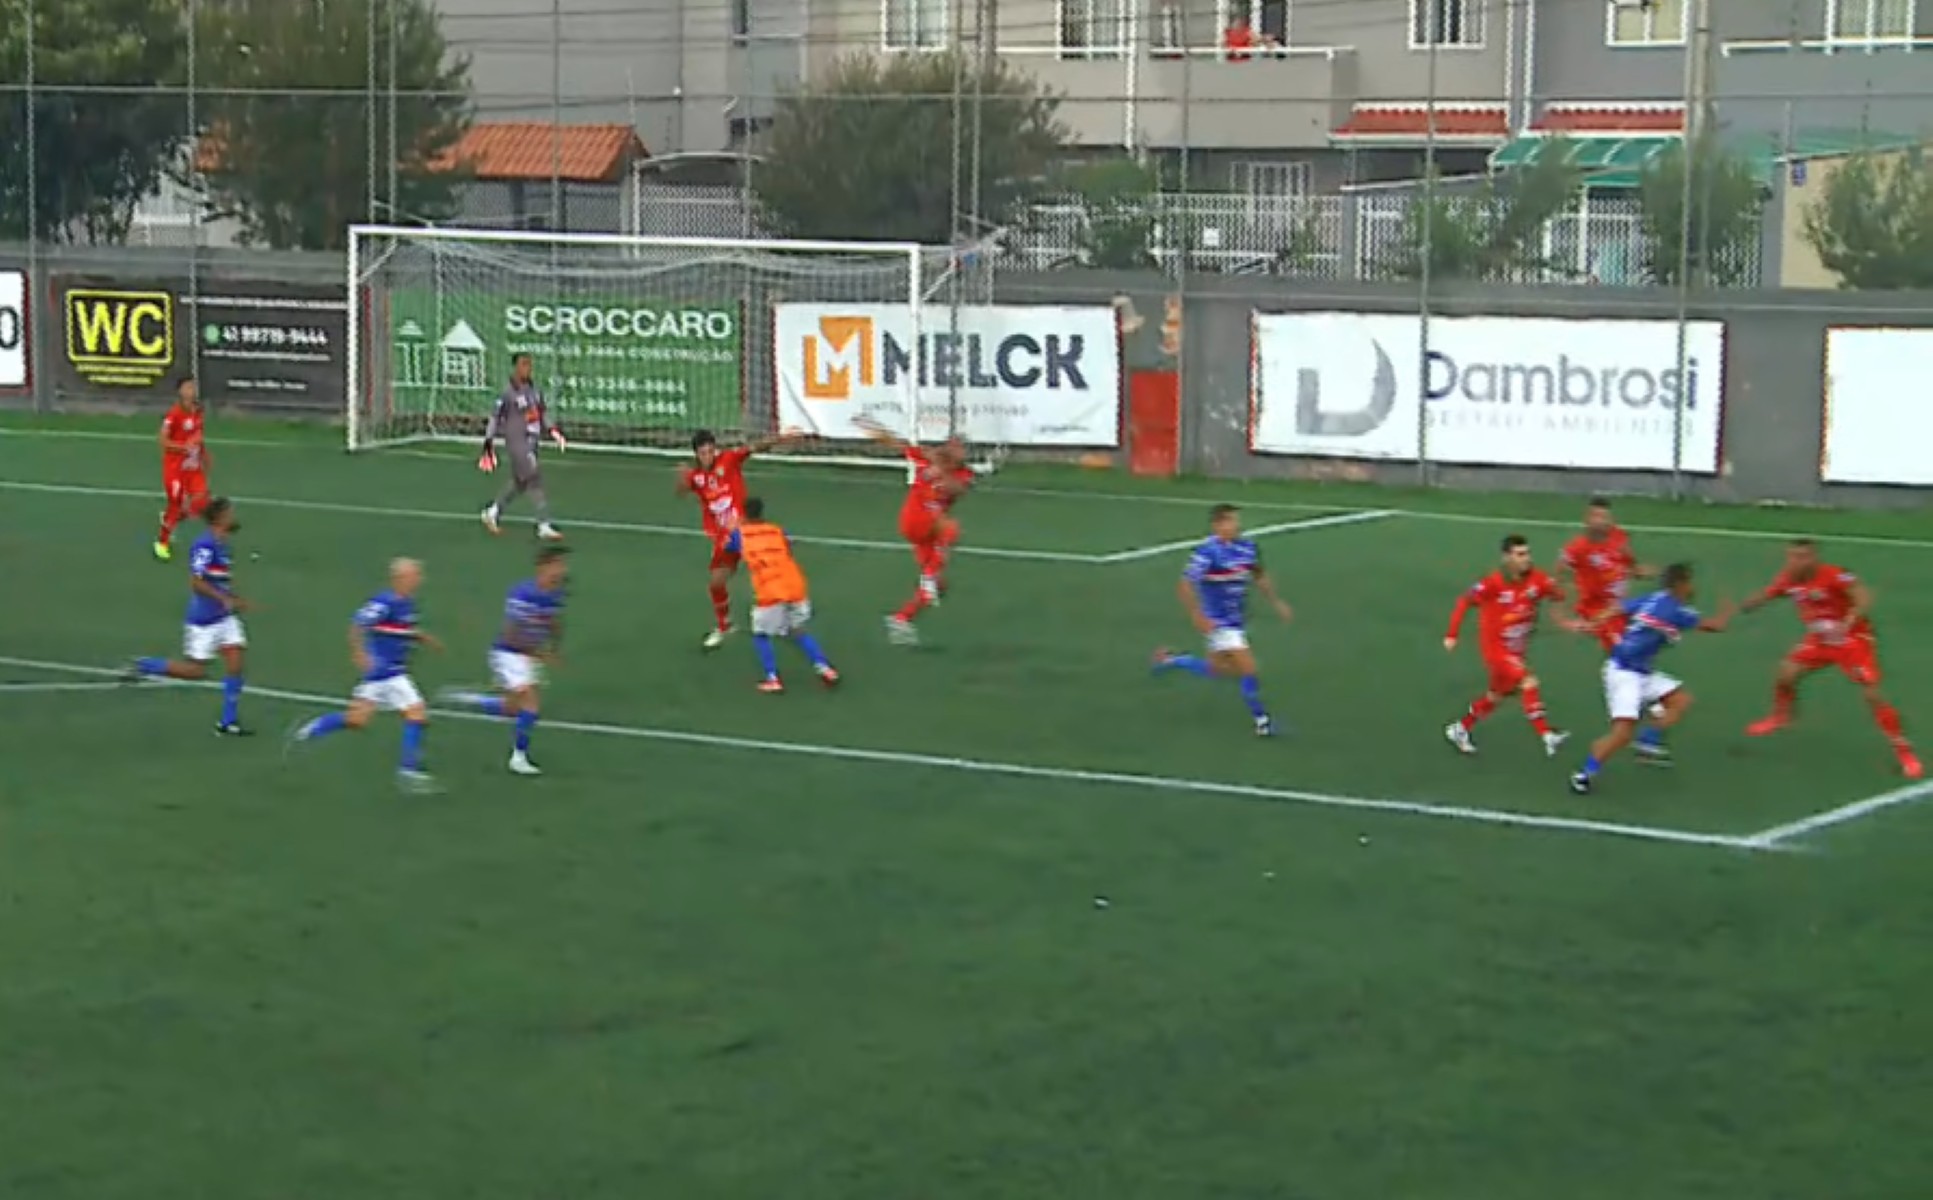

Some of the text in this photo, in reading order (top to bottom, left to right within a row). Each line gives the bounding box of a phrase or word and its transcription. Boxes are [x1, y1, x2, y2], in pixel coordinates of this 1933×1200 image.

[75, 301, 164, 355] WC
[505, 305, 733, 339] SCROCCARO
[1424, 350, 1698, 410] Dambrosi
